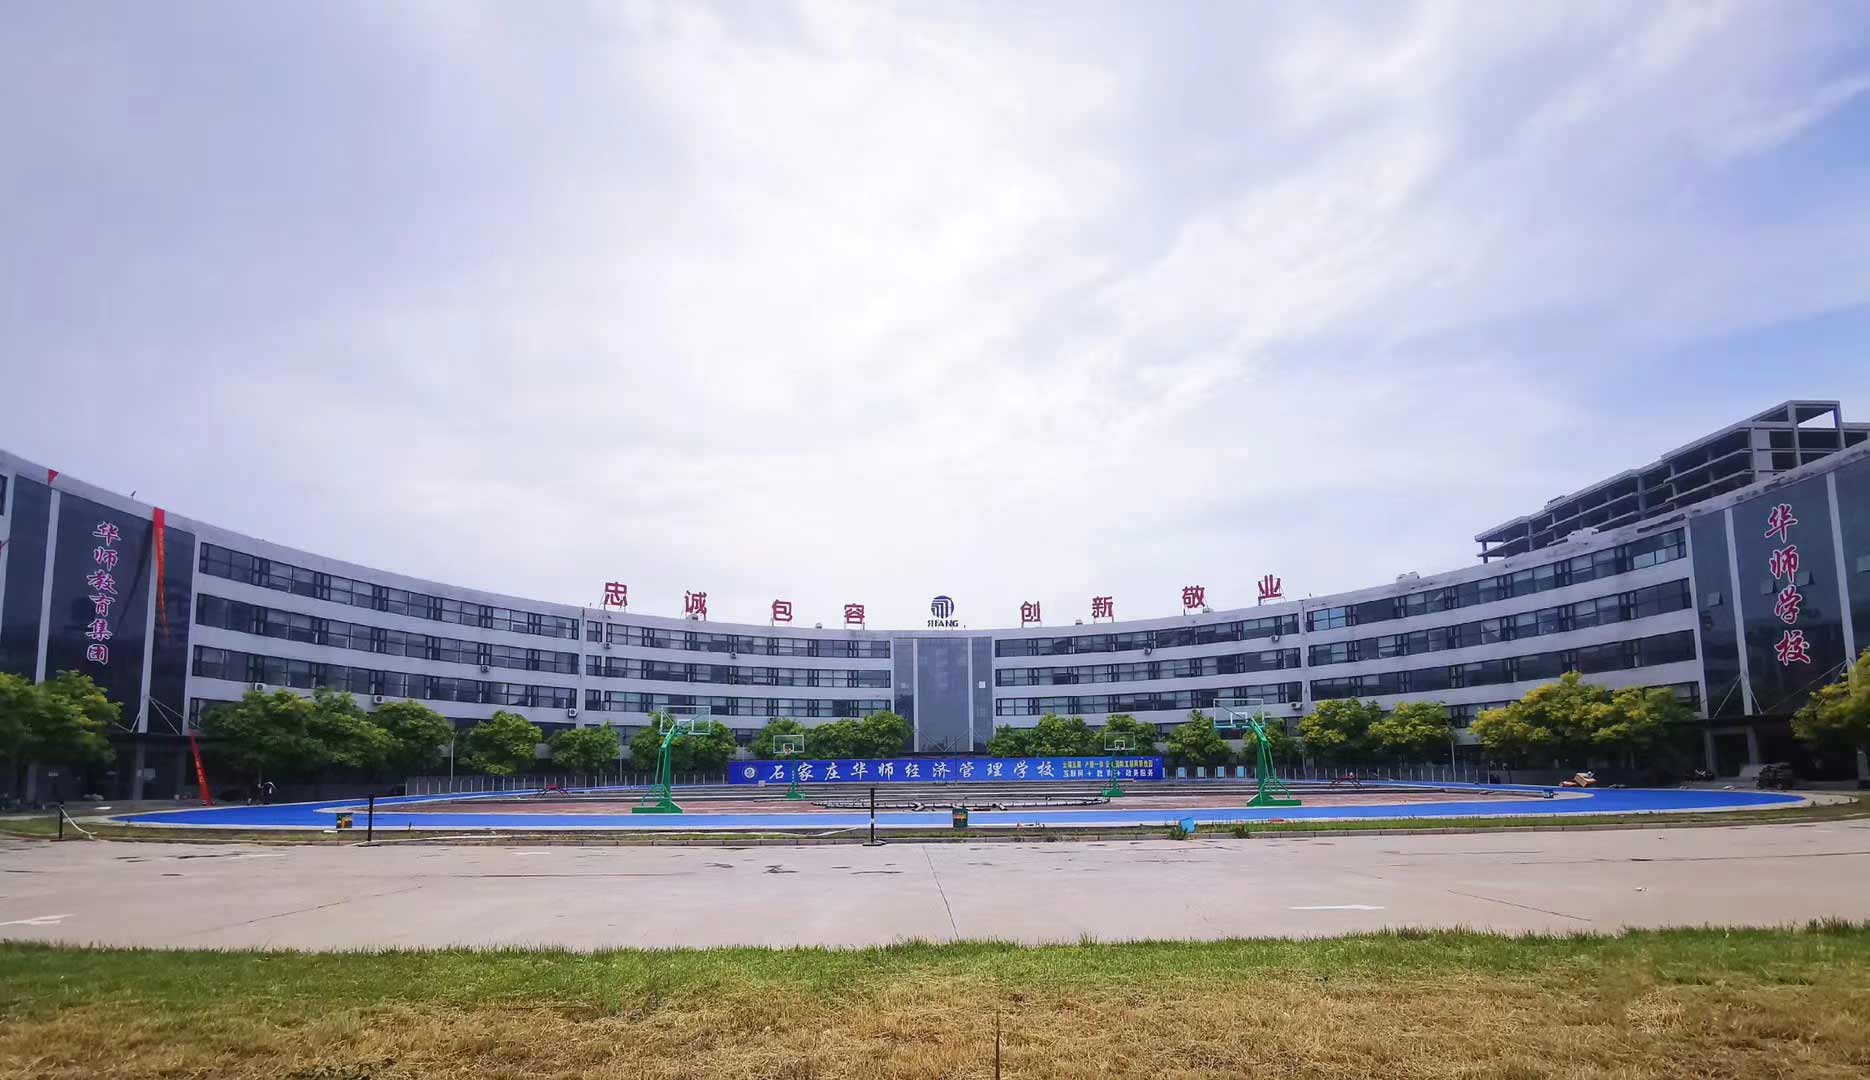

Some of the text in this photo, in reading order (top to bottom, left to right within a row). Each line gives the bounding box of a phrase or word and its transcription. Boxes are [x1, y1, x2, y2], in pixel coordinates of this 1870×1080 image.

[85, 521, 122, 665] 华师教育集团
[1764, 503, 1811, 666] 华师学校
[769, 760, 1055, 781] 石家庄华师经济管理学校
